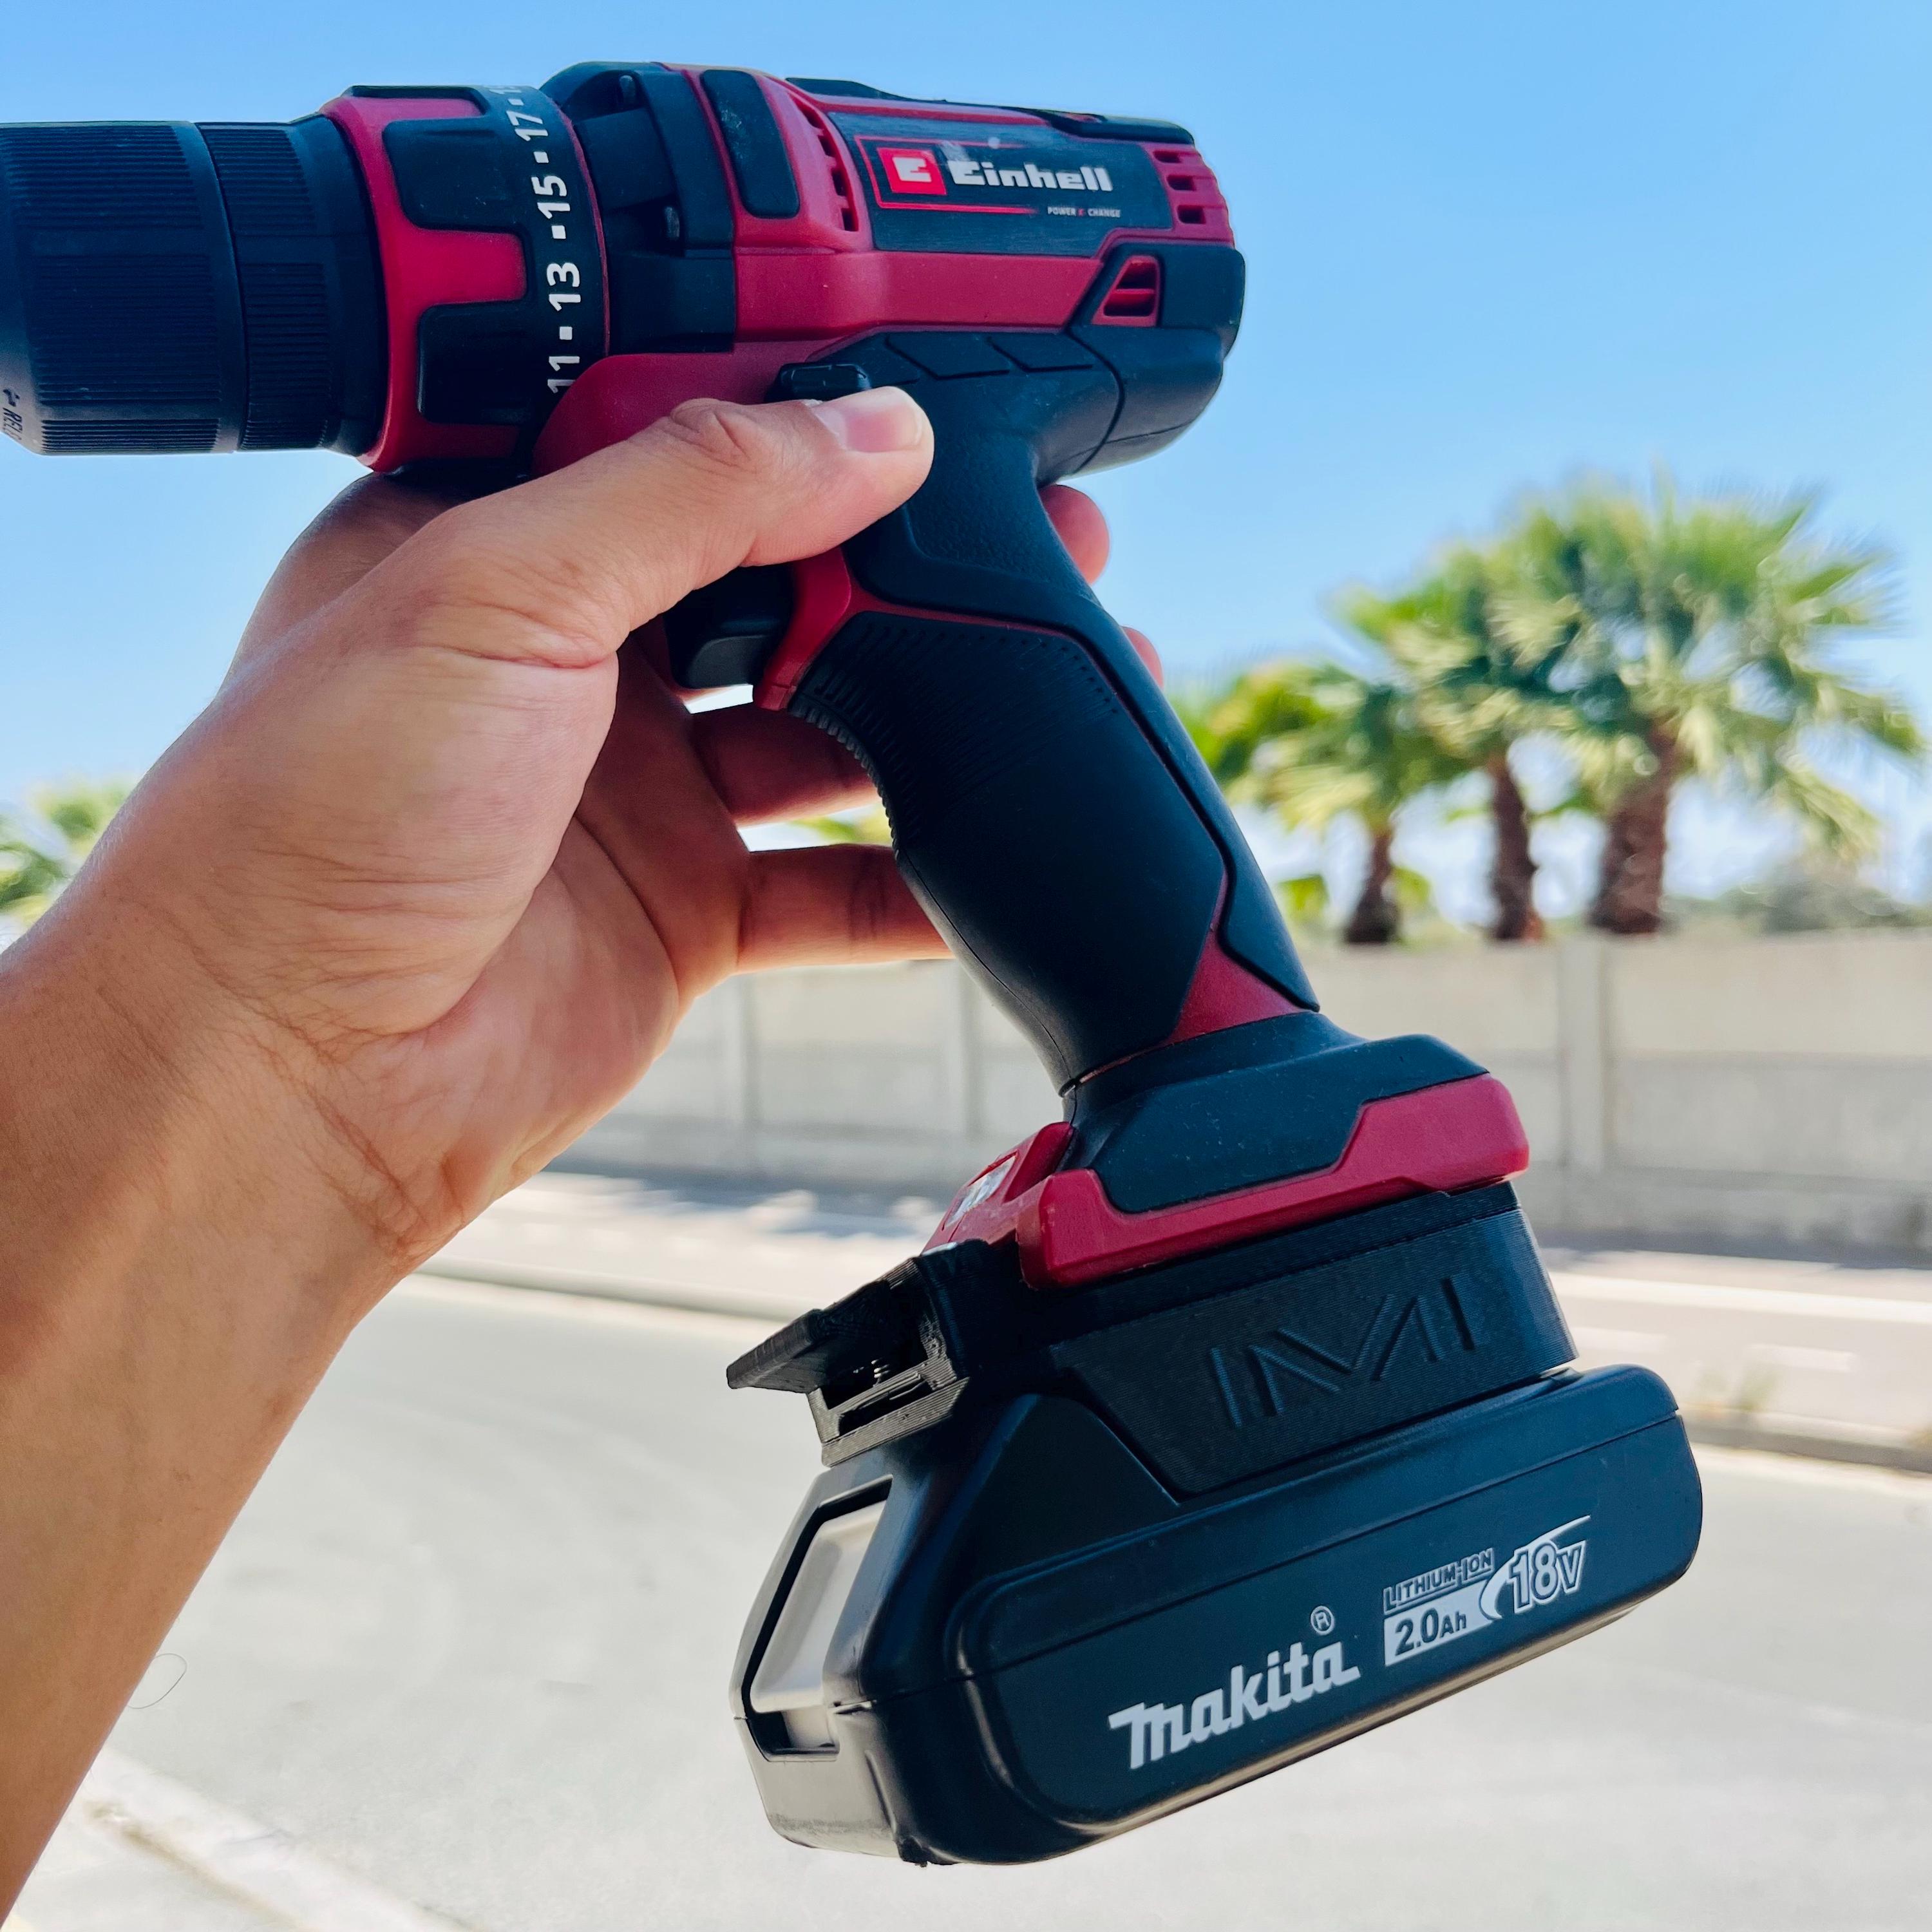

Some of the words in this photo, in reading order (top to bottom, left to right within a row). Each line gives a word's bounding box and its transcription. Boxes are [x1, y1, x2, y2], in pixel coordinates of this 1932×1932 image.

[506, 110, 549, 141] 17
[947, 159, 1113, 192] Einhell
[531, 175, 571, 218] 15
[1047, 205, 1077, 216] POWER
[546, 262, 581, 311] 13
[547, 355, 580, 393] 11
[1384, 1548, 1494, 1612] LITHIUM-ION
[1395, 1607, 1467, 1650] 2.0Ah
[1509, 1540, 1586, 1613] 18V
